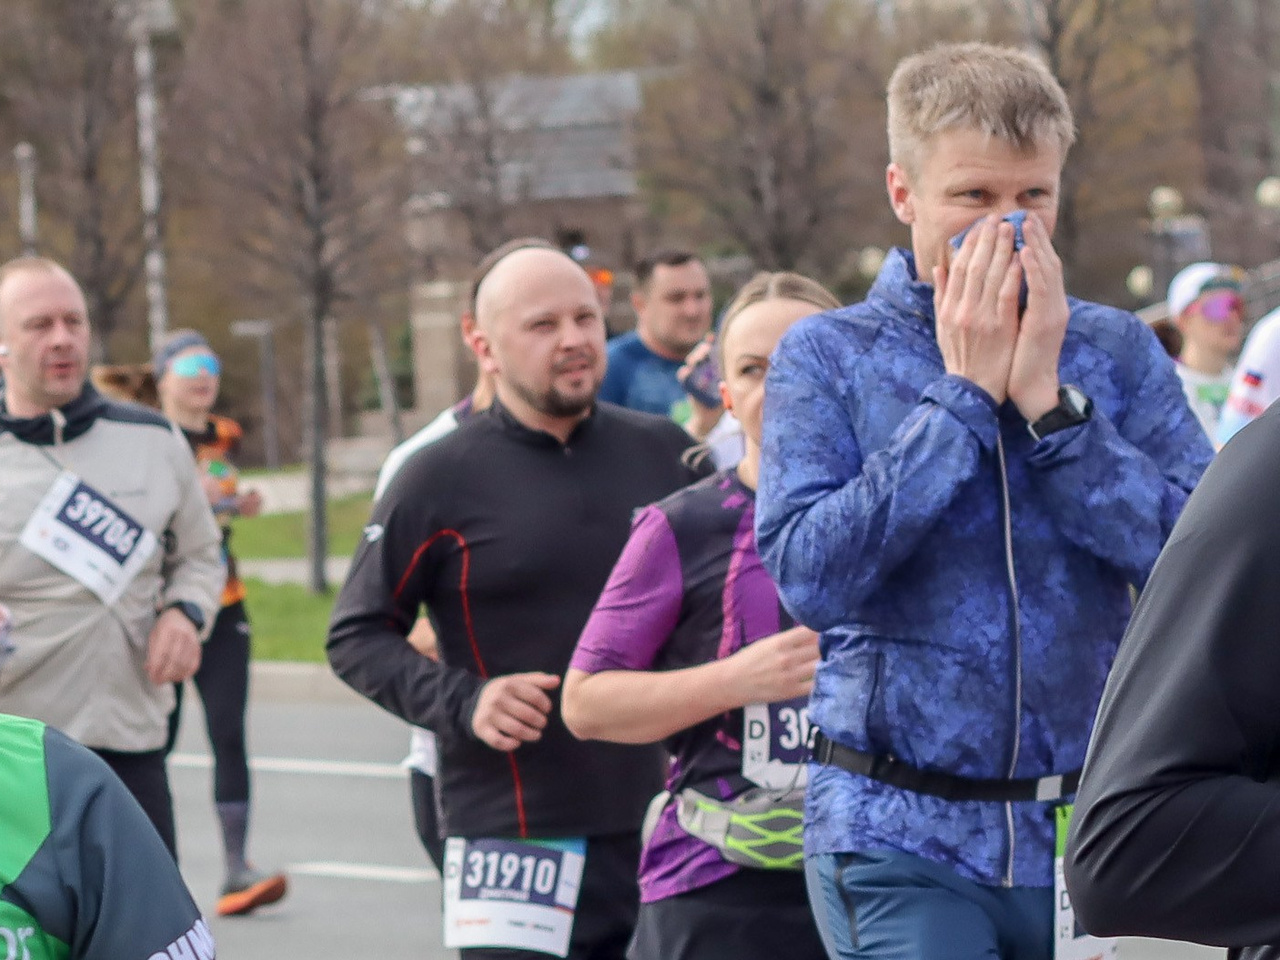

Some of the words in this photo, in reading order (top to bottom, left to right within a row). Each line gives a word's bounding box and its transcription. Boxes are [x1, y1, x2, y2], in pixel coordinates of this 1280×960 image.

[65, 491, 139, 556] 39706
[748, 720, 766, 740] D
[465, 850, 558, 895] 31910
